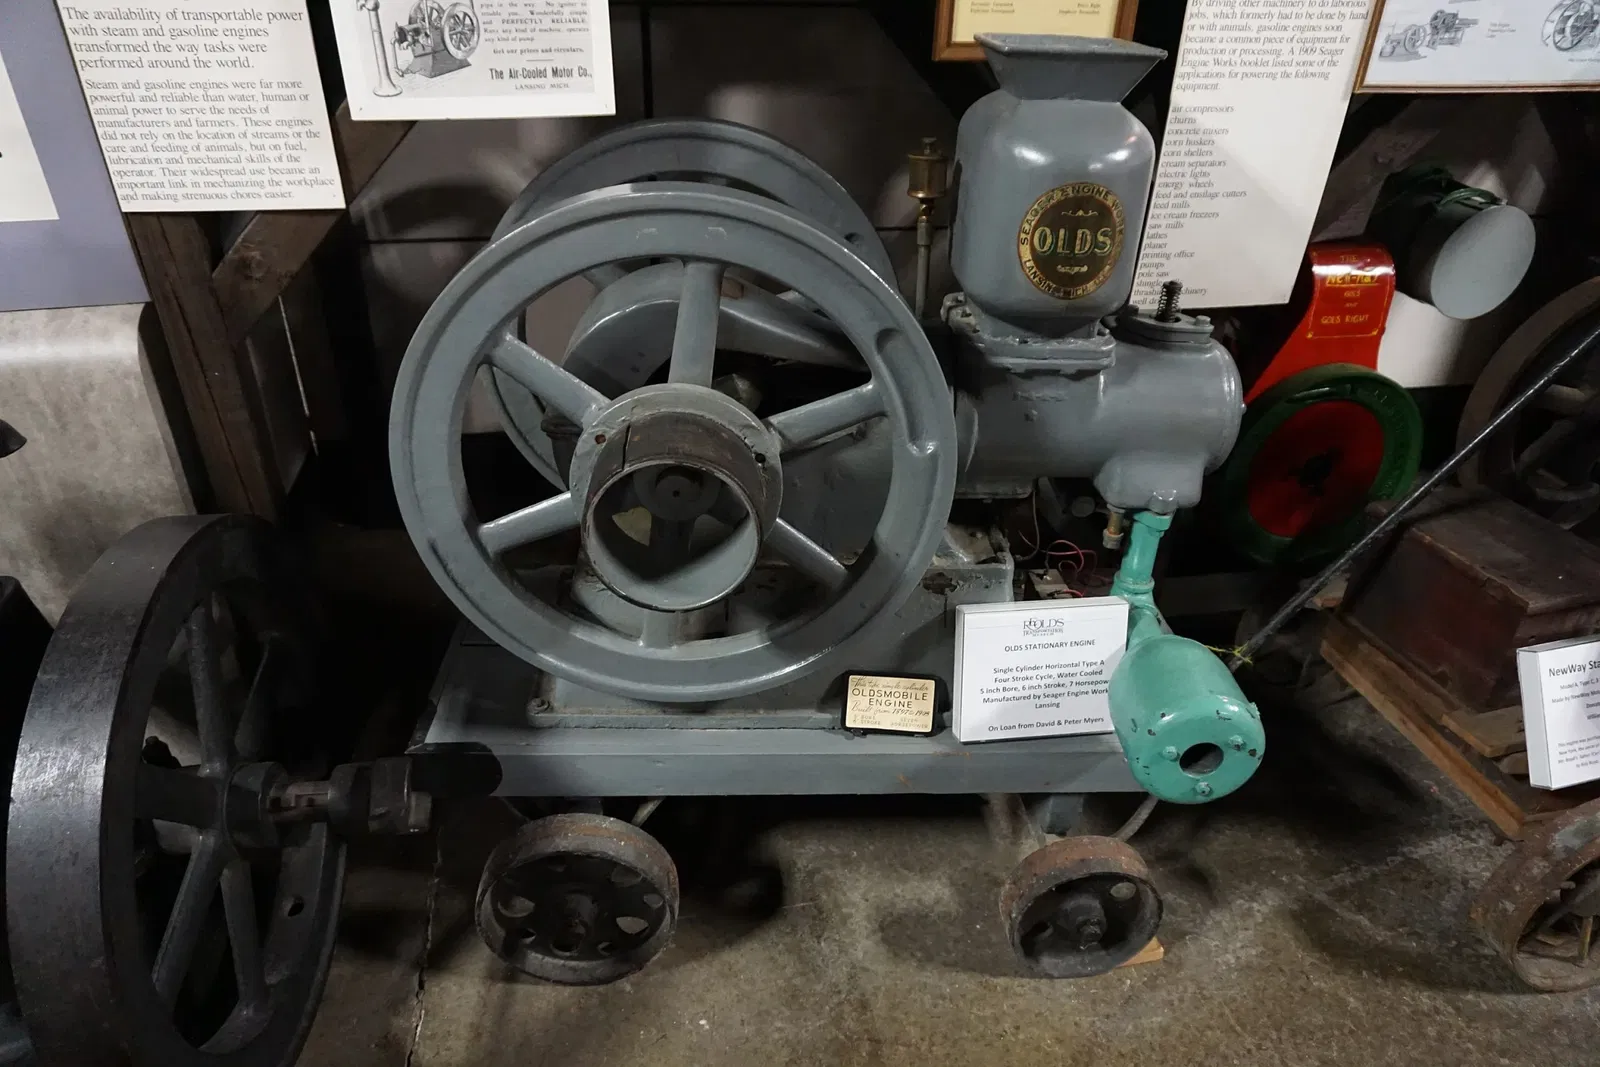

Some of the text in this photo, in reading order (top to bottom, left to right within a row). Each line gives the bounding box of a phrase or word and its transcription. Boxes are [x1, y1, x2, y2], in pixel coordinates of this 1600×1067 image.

[63, 7, 304, 24] The availability of transportable power
[1187, 9, 1209, 21] jobs,
[1212, 9, 1237, 20] which
[1239, 9, 1275, 22] formerly
[1277, 10, 1293, 20] had
[1304, 10, 1316, 19] be
[1317, 10, 1336, 20] done
[1337, 10, 1346, 22] by
[1349, 10, 1369, 20] hand
[69, 24, 269, 40] with steam and gasoline engines
[74, 40, 268, 55] transformed the way tasks were
[78, 56, 254, 71] performed around the world.
[489, 65, 593, 80] The Air-Cooled Motor Co.,
[85, 78, 303, 92] Steam and gasoline engines were far more
[90, 90, 310, 104] powerful and reliable than water, human or
[93, 105, 129, 115] animal
[132, 107, 163, 117] power
[166, 107, 177, 115] to
[210, 104, 225, 114] the
[229, 104, 257, 114] needs
[260, 104, 270, 114] of
[1185, 105, 1234, 115] compressors
[1169, 116, 1197, 124] churns
[1165, 137, 1215, 147] corn huskers
[1183, 148, 1213, 156] shellers
[1188, 159, 1226, 169] separators
[111, 169, 156, 179] operator.
[158, 167, 186, 177] Their
[189, 166, 247, 178] widespread
[268, 166, 305, 176] became
[308, 166, 321, 174] an
[1157, 181, 1184, 190] energy
[1173, 189, 1187, 198] and
[1189, 188, 1220, 200] ensilage
[1033, 226, 1112, 256] OLDS
[1141, 250, 1171, 261] printing
[1004, 639, 1095, 652] OLDS STATIONARY ENGINE
[993, 667, 1014, 675] Single
[1015, 664, 1043, 674] Cylinder
[1045, 660, 1080, 670] Horizontal
[1082, 660, 1098, 669] Type
[1548, 663, 1587, 677] NewWay
[1035, 673, 1055, 682] Cycle,
[1080, 669, 1103, 677] Cooled
[986, 685, 1000, 694] inch
[1002, 685, 1020, 693] Bore,
[1028, 682, 1042, 690] inch
[1044, 681, 1067, 689] Stroke,
[1075, 679, 1109, 688] Horsepow
[852, 687, 929, 701] OLDSMOBILE
[982, 687, 1109, 703] Manufactured by Seager Engine Work
[869, 697, 912, 708] ENGINE
[1035, 701, 1060, 709] Lansing
[1000, 723, 1017, 731] Loan
[1036, 720, 1055, 728] David
[1064, 718, 1082, 726] Peter
[1083, 716, 1104, 726] Myers
